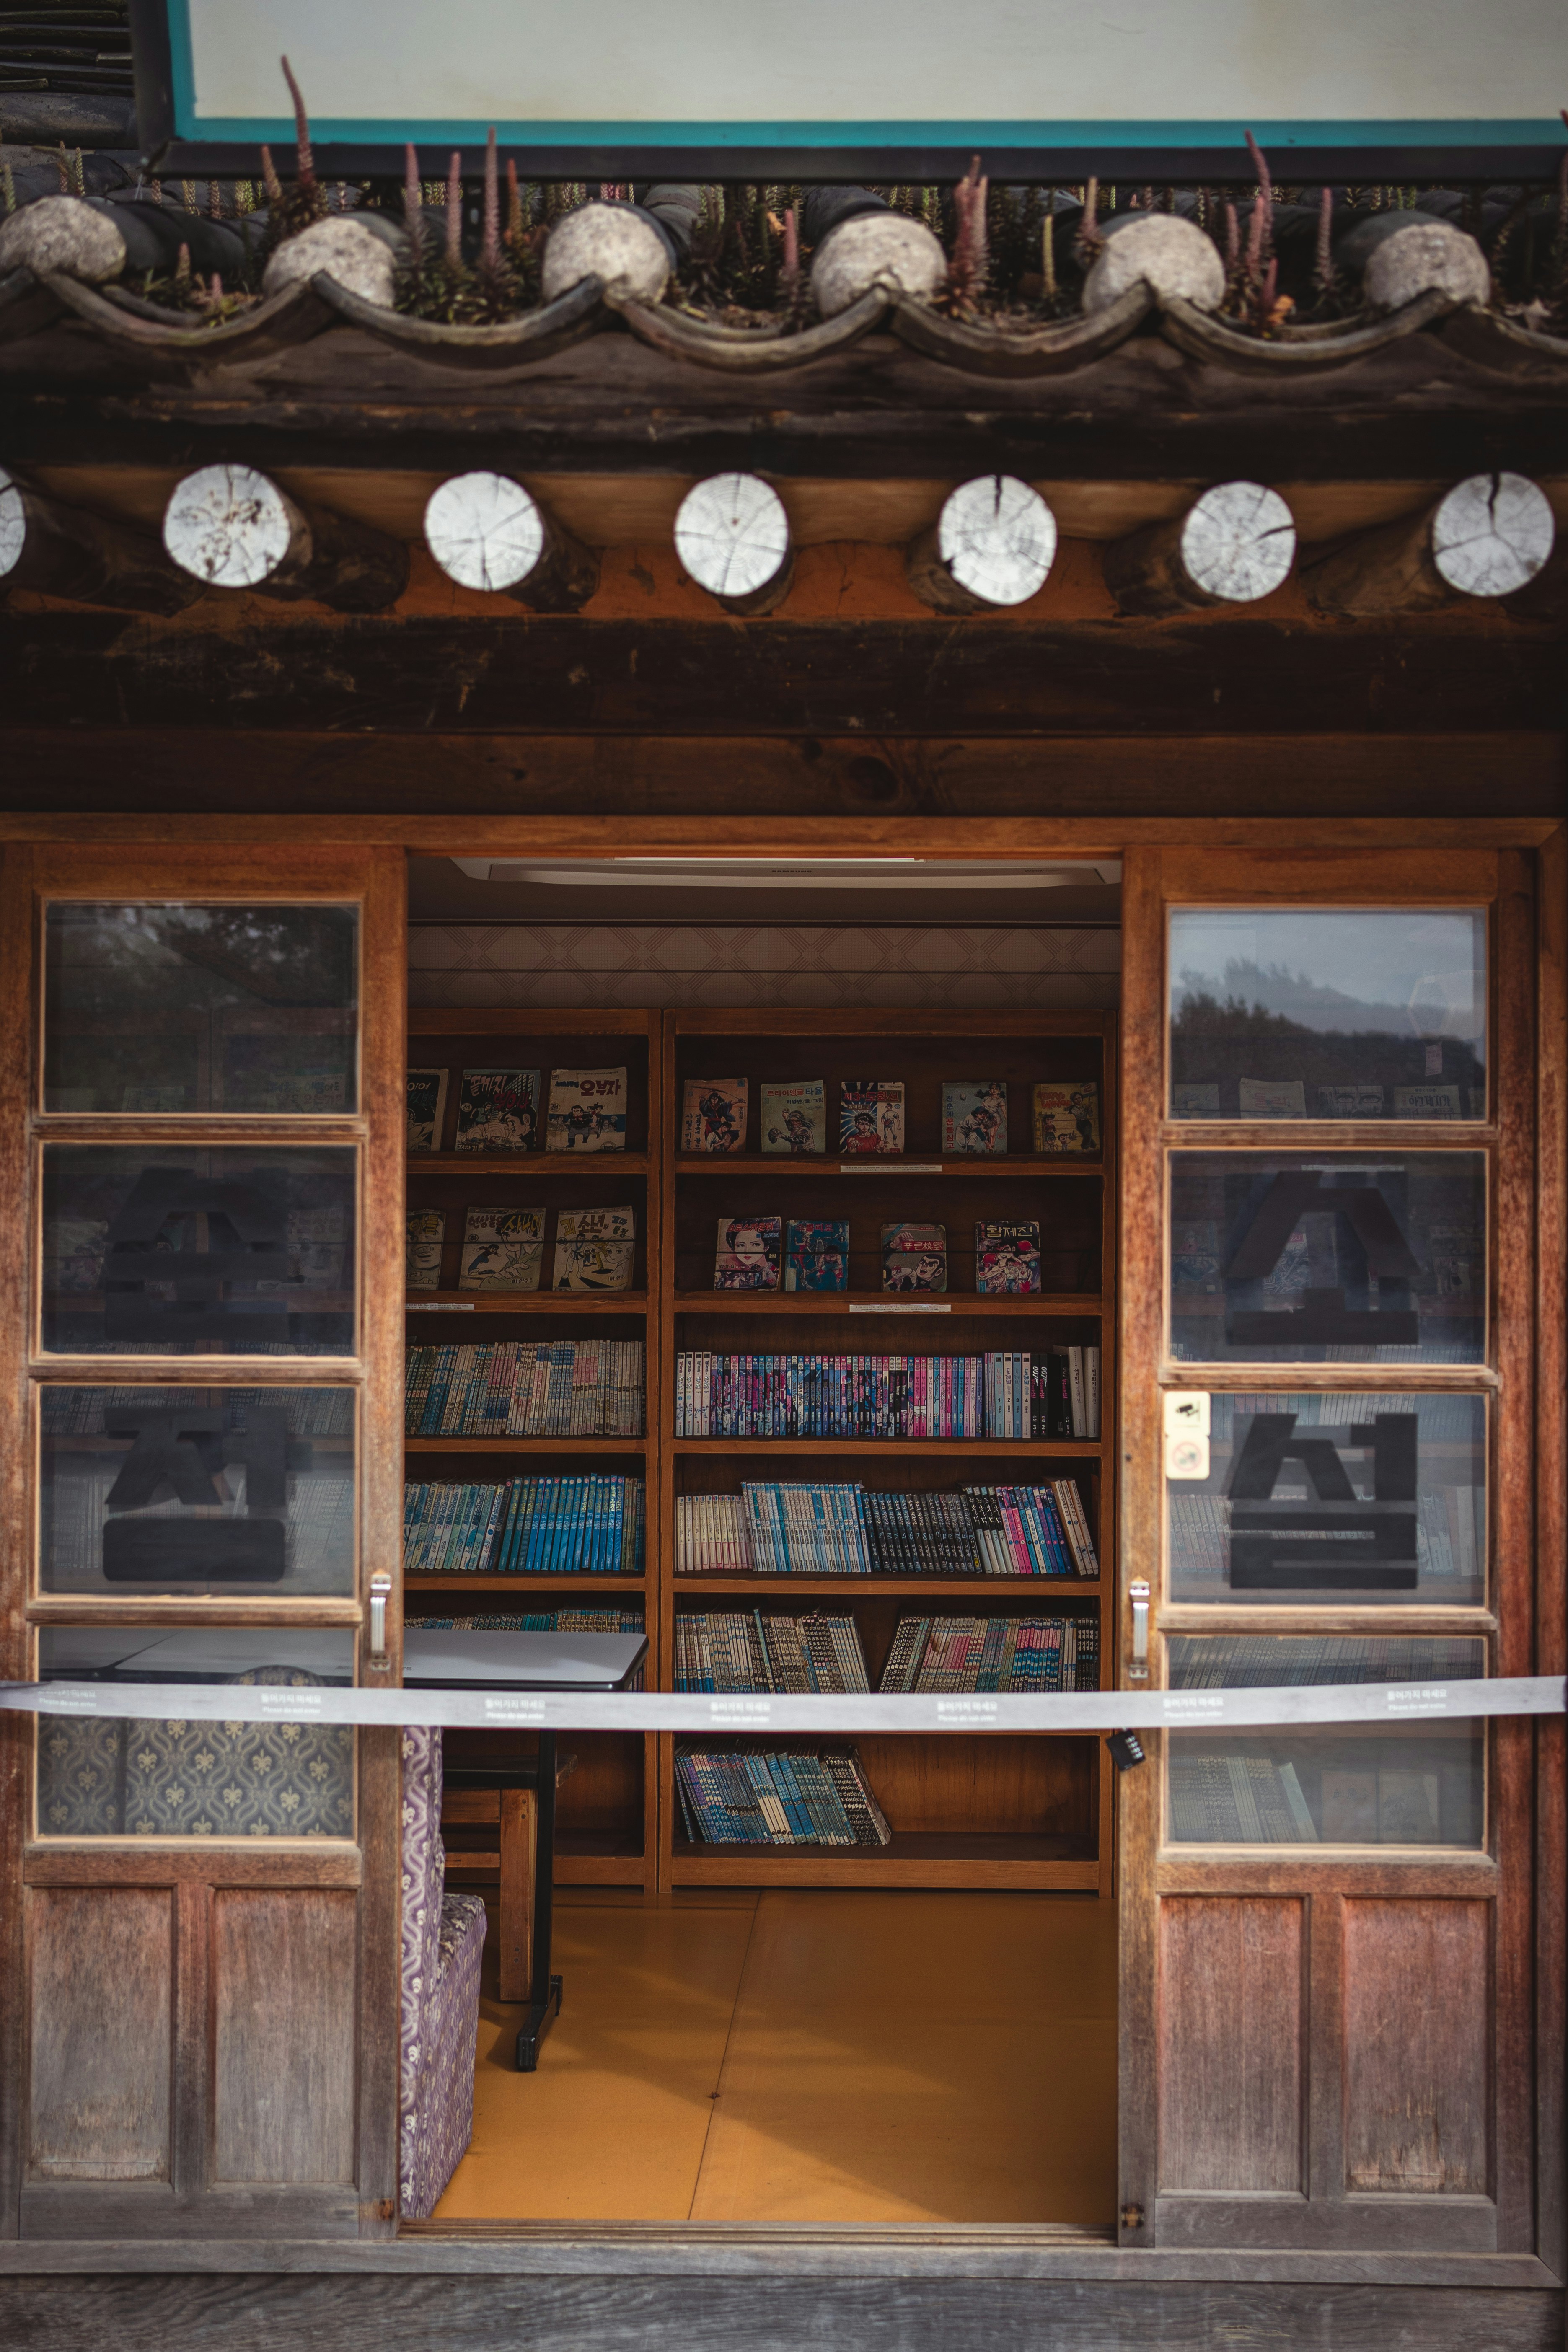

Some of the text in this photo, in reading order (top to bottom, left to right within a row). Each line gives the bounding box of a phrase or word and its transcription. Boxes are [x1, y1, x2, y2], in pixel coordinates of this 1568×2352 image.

[470, 1075, 507, 1097] 끝까지
[580, 1079, 621, 1096] 오부자
[805, 1087, 823, 1096] 타율
[866, 1092, 900, 1102] 도화선
[946, 1118, 954, 1133] 꿈을
[503, 1214, 543, 1232] 사나이
[727, 1222, 774, 1232] 크로스카운터
[795, 1223, 833, 1232] 스콜피오
[986, 1224, 1033, 1237] 황제전
